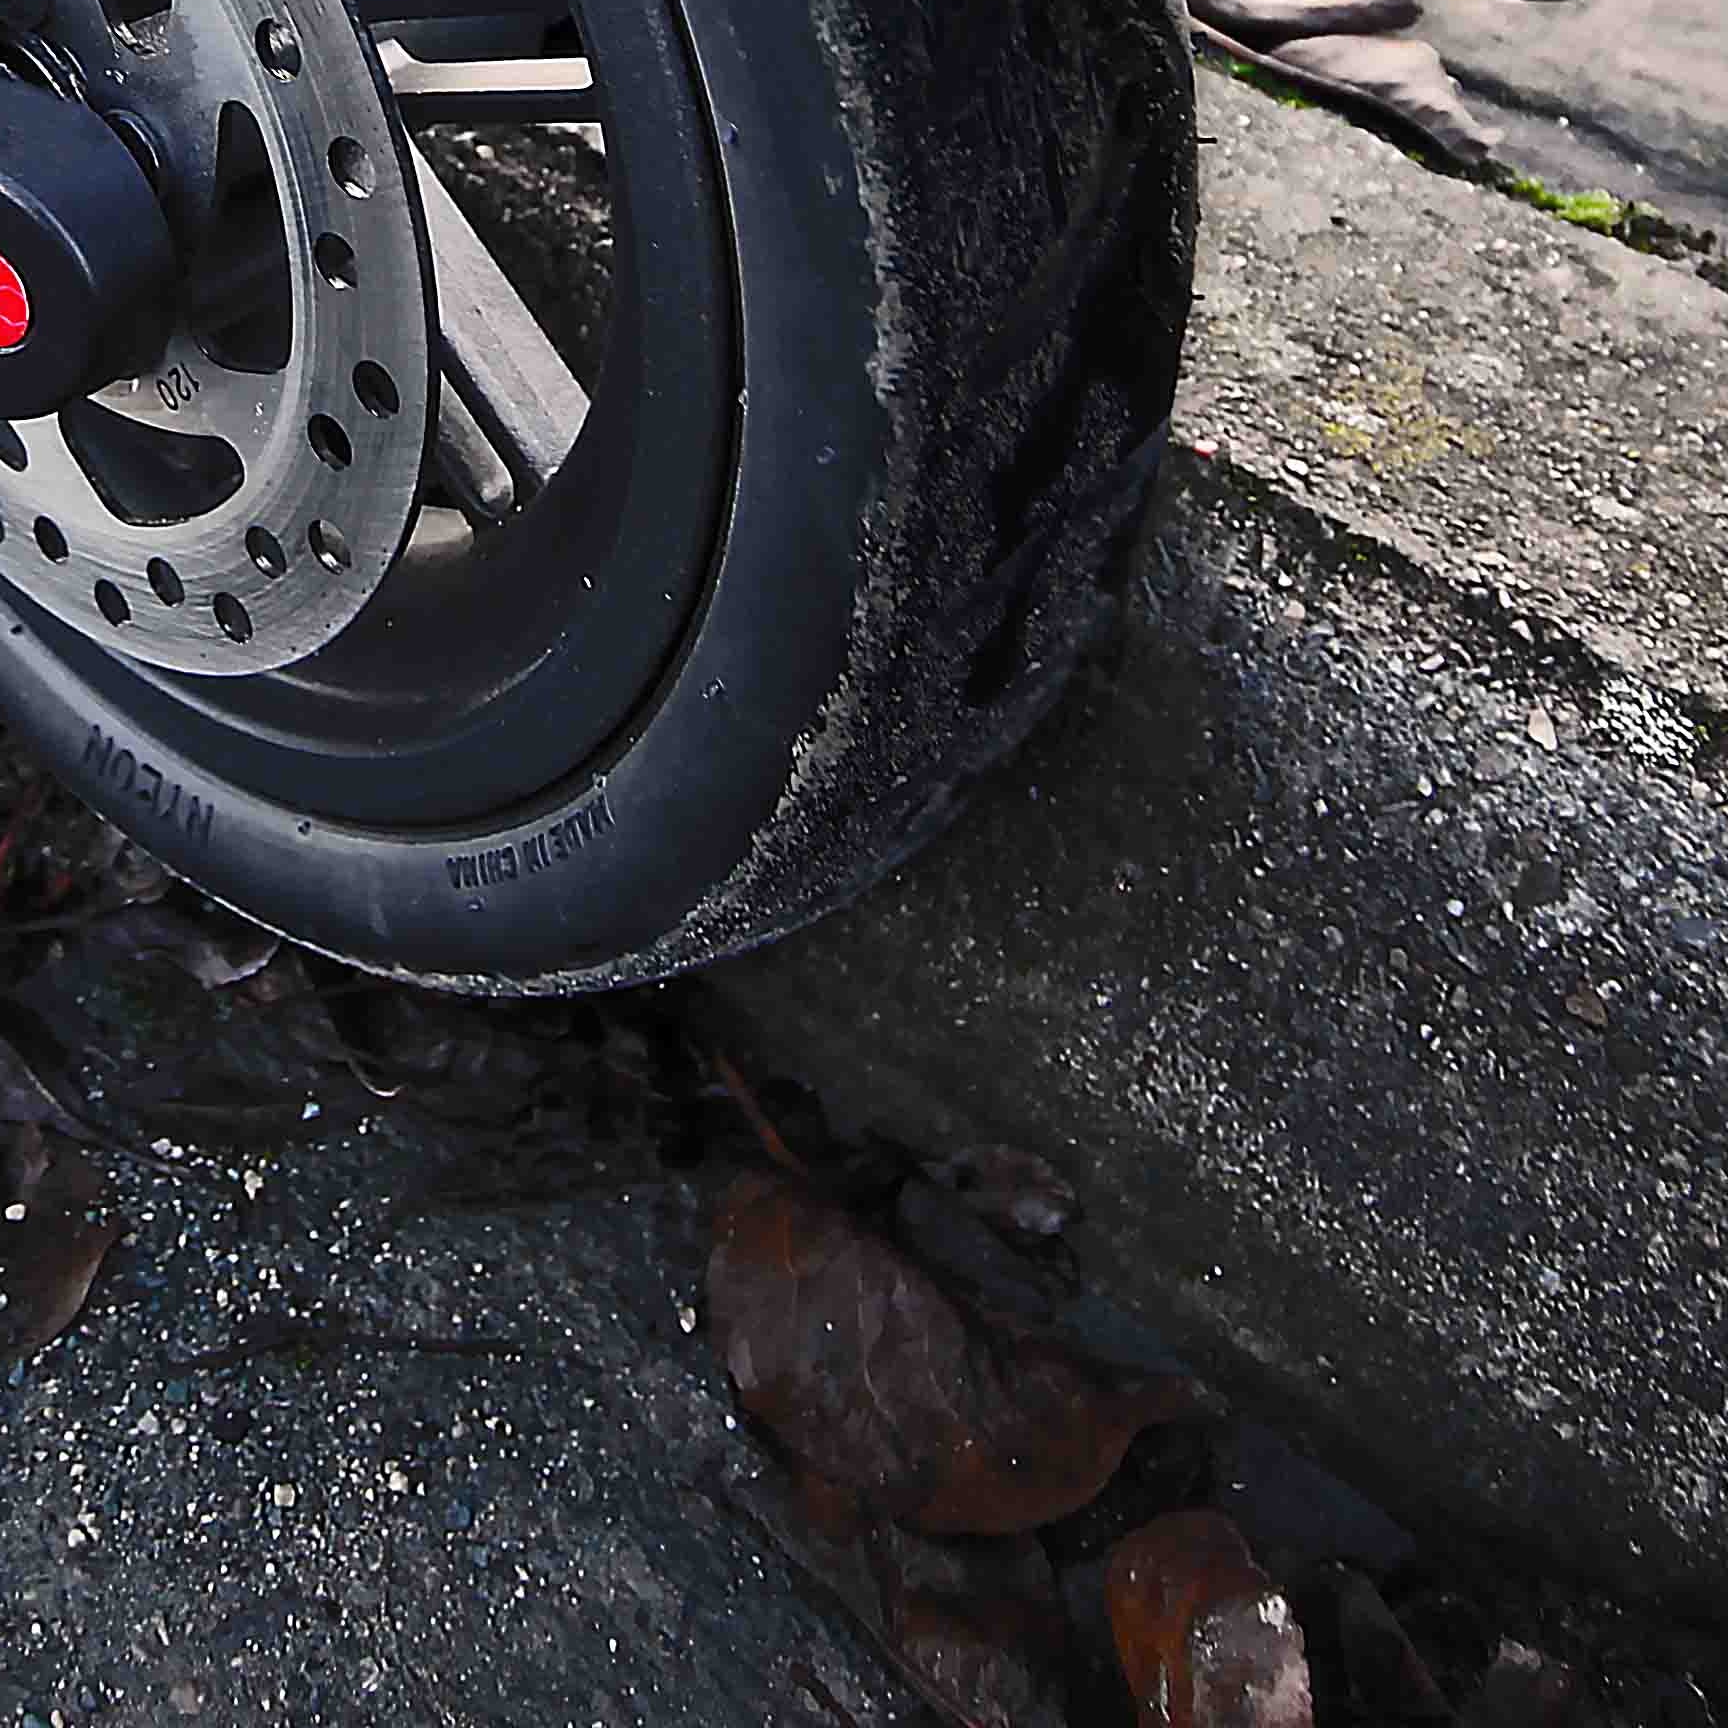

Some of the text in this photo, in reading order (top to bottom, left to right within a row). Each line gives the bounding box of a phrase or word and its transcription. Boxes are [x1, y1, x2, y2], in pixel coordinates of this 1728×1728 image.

[156, 361, 201, 411] 120
[81, 723, 215, 842] NYLON
[444, 789, 616, 890] MADE IN CHINA
